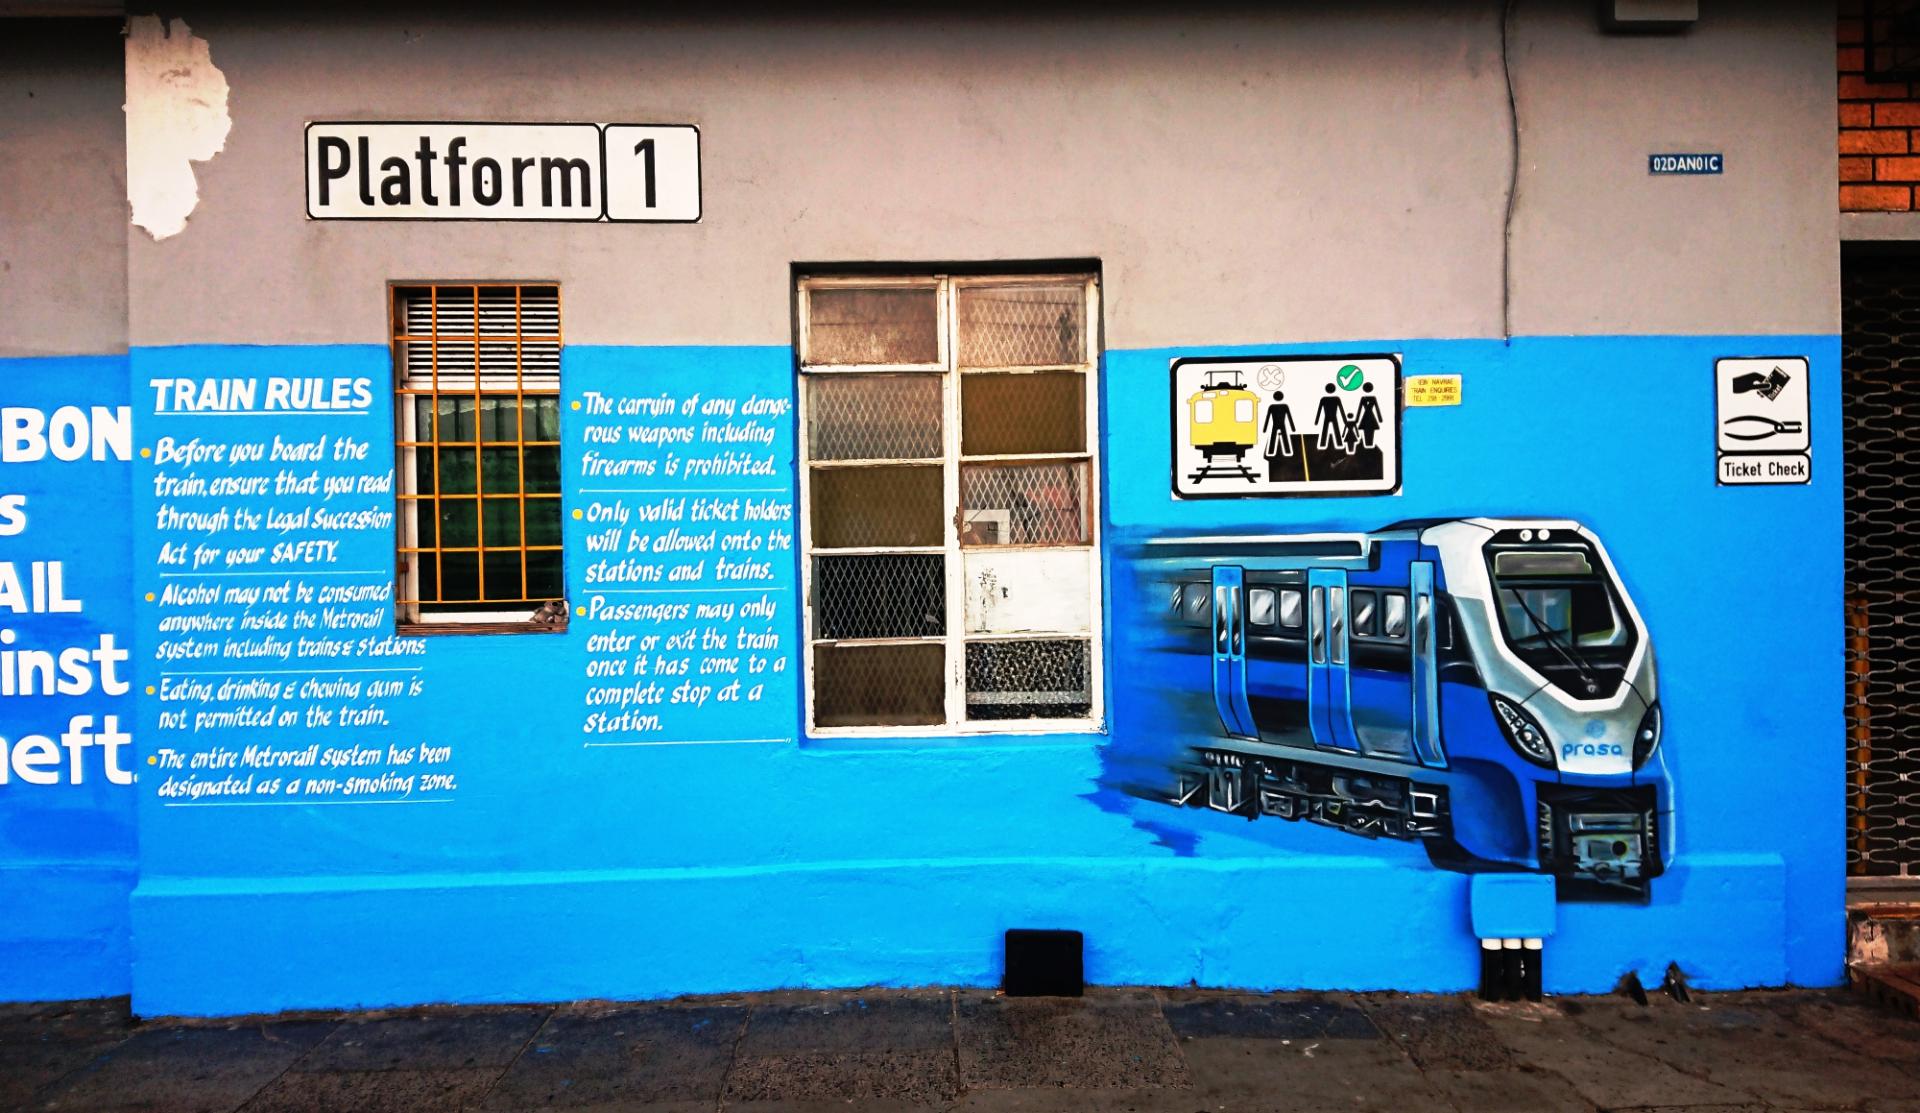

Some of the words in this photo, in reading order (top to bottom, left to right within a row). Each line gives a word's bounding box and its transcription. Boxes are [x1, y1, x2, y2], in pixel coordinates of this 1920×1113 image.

[318, 136, 591, 207] Platform
[634, 138, 656, 208] 1
[149, 378, 257, 412] TRAIN
[264, 377, 373, 410] RULES
[583, 391, 614, 415] The
[617, 393, 676, 417] carryin
[681, 393, 699, 417] of
[701, 398, 736, 418] any
[741, 394, 792, 419] dange-
[583, 425, 623, 444] rous
[628, 426, 695, 448] weapons
[701, 420, 775, 446] including
[154, 436, 227, 467] Before
[229, 443, 265, 465] you
[269, 434, 327, 462] board
[333, 437, 369, 461] the
[582, 451, 657, 477] firearms
[664, 452, 680, 476] is
[684, 451, 776, 480] prohibited.
[1724, 463, 1761, 476] Ticket
[1768, 461, 1805, 475] Check
[275, 469, 320, 495] that
[323, 476, 355, 500] you
[356, 469, 394, 494] read
[156, 504, 229, 534] through
[234, 508, 262, 531] the
[266, 506, 311, 535] Legal
[310, 505, 393, 530] Succession
[586, 500, 630, 526] Only
[638, 497, 686, 522] valid
[691, 498, 740, 522] ticket
[743, 498, 792, 521] holders
[157, 542, 188, 565] Act
[193, 545, 221, 569] for
[225, 547, 265, 566] your
[270, 540, 339, 564] SAFETY.
[586, 528, 622, 552] will
[627, 529, 650, 553] be
[652, 527, 716, 553] allowed
[721, 529, 762, 552] onto
[767, 529, 792, 551] the
[585, 558, 664, 583] stations
[668, 560, 705, 582] and
[715, 556, 774, 581] trains.
[159, 583, 221, 606] Alcohol
[224, 587, 261, 608] may
[262, 580, 291, 603] not
[295, 581, 314, 604] be
[317, 581, 392, 604] consumed
[158, 613, 235, 636] anywhere
[240, 610, 288, 630] inside
[293, 610, 316, 630] the
[323, 606, 385, 629] Metrorail
[589, 595, 690, 624] Passengers
[695, 603, 735, 622] may
[739, 594, 776, 620] only
[155, 638, 219, 664] system
[223, 635, 292, 659] including
[586, 629, 636, 653] enter
[640, 635, 660, 651] or
[665, 628, 697, 651] exit
[702, 627, 728, 650] the
[737, 626, 779, 650] train
[586, 659, 627, 678] once
[634, 654, 648, 675] it
[654, 655, 690, 675] has
[699, 657, 739, 674] come
[748, 654, 767, 674] to
[773, 656, 786, 673] a
[300, 677, 361, 699] chewing
[366, 680, 404, 698] gum
[408, 675, 423, 696] is
[585, 681, 665, 709] complete
[670, 679, 711, 707] stop
[717, 679, 741, 702] at
[748, 684, 764, 701] a
[159, 710, 187, 729] not
[194, 705, 276, 731] permitted
[278, 711, 298, 727] on
[306, 705, 332, 728] the
[339, 703, 389, 727] train.
[158, 748, 185, 769] The
[190, 747, 238, 769] entire
[240, 744, 319, 768] Metrorail
[320, 744, 382, 768] system
[386, 744, 416, 765] has
[419, 743, 451, 764] been
[1563, 742, 1624, 761] prasa
[158, 774, 253, 800] designated
[256, 778, 281, 795] as
[285, 779, 301, 794] a
[305, 771, 415, 795] non-smoking
[419, 774, 457, 791] zone.
